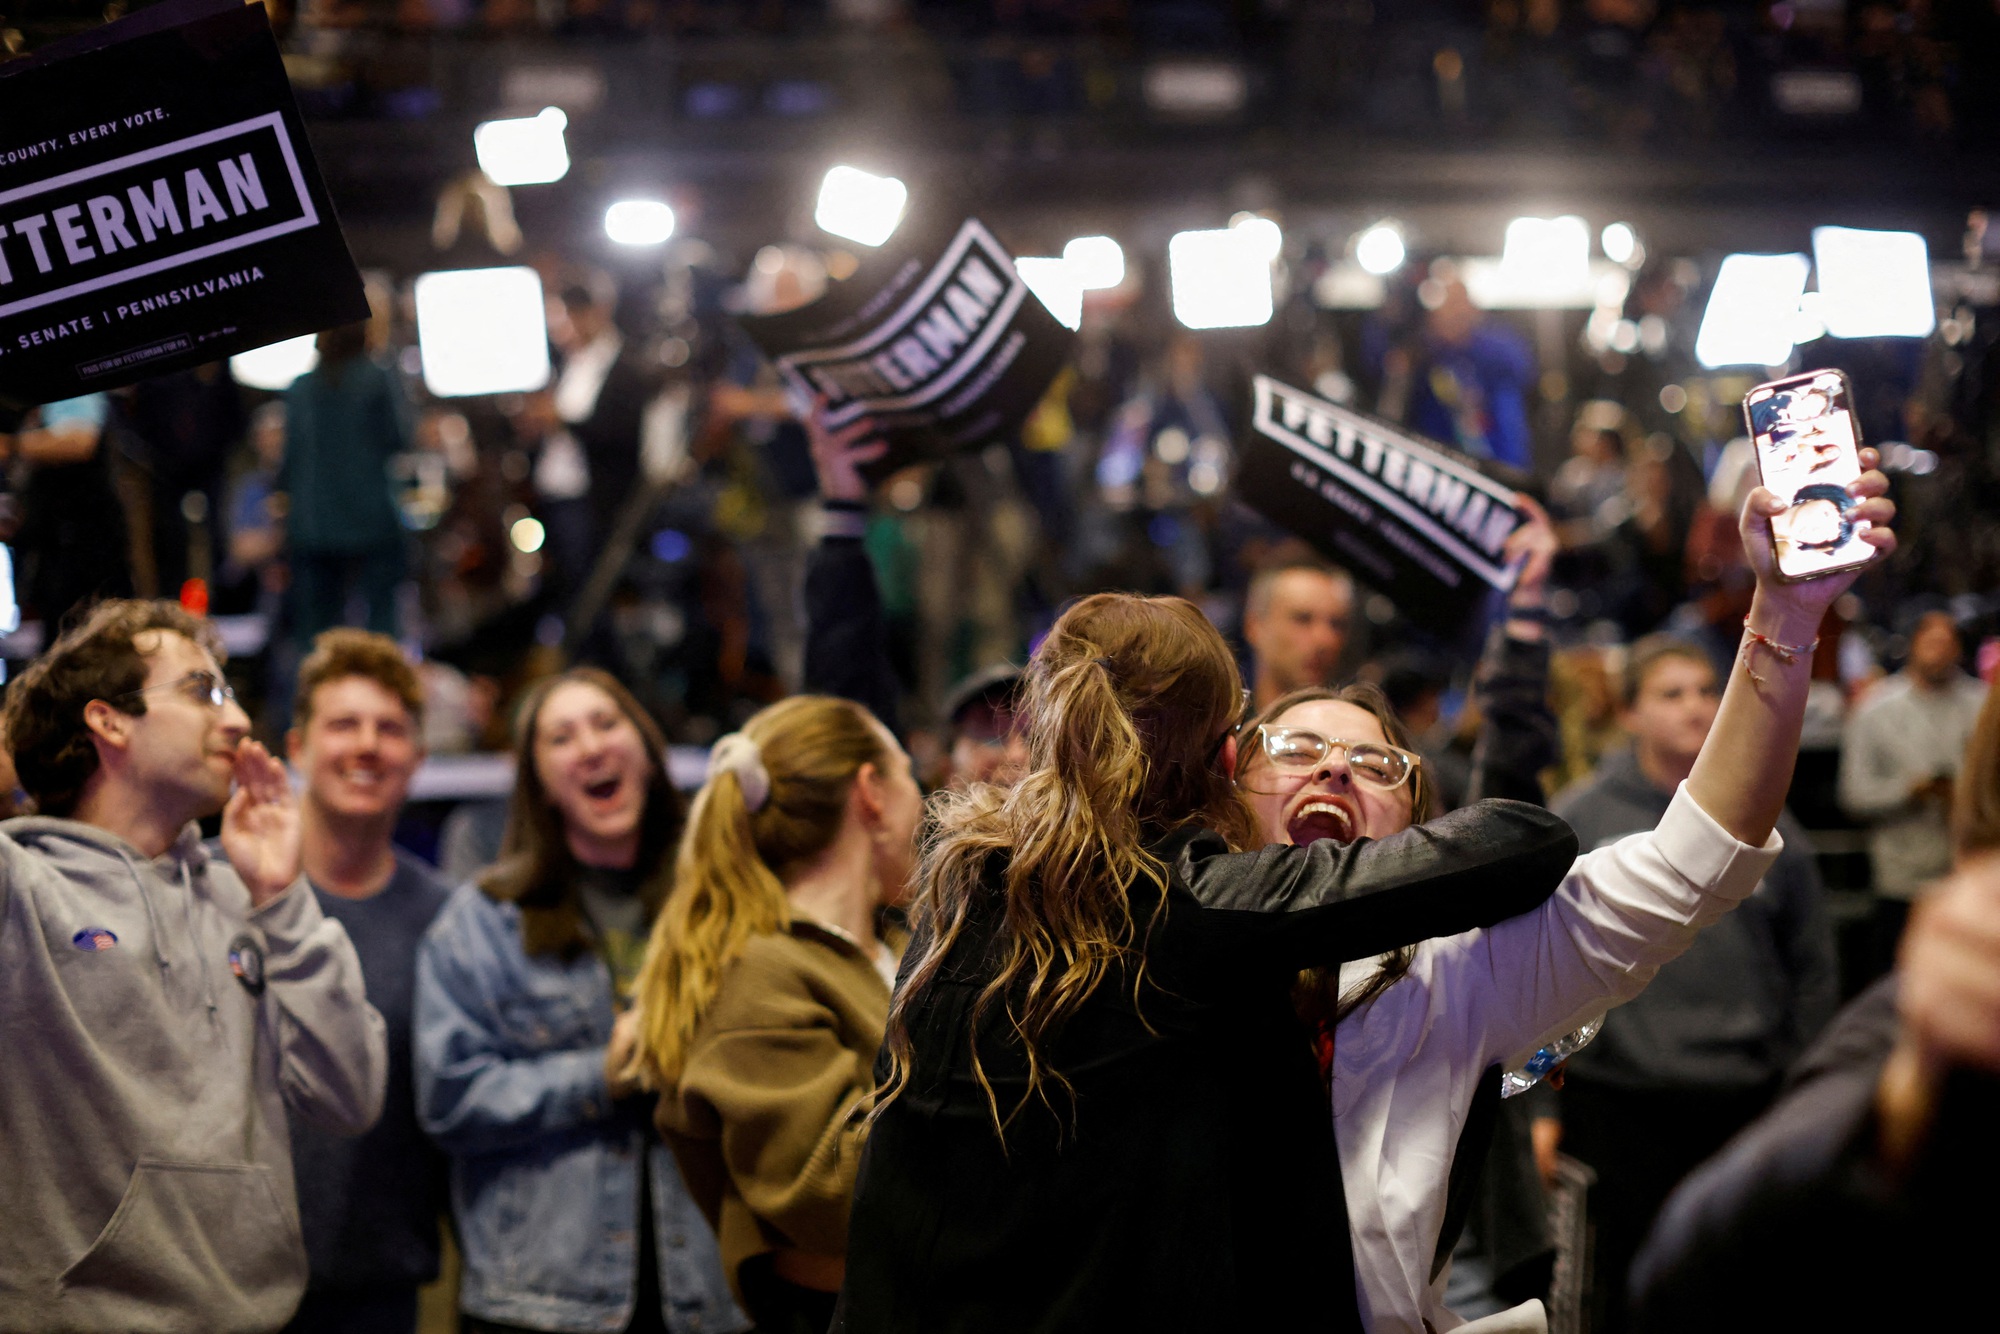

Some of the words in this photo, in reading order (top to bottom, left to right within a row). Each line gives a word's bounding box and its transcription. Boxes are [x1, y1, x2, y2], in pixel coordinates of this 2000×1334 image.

[0, 138, 63, 166] COUNTY.
[68, 121, 118, 145] EVERY
[123, 107, 171, 129] VOTE.
[17, 315, 95, 349] SENATE
[116, 266, 265, 321] PENNSYLVANIA
[123, 346, 163, 364] FETTERMAN
[1283, 396, 1517, 556] FETTERMAN
